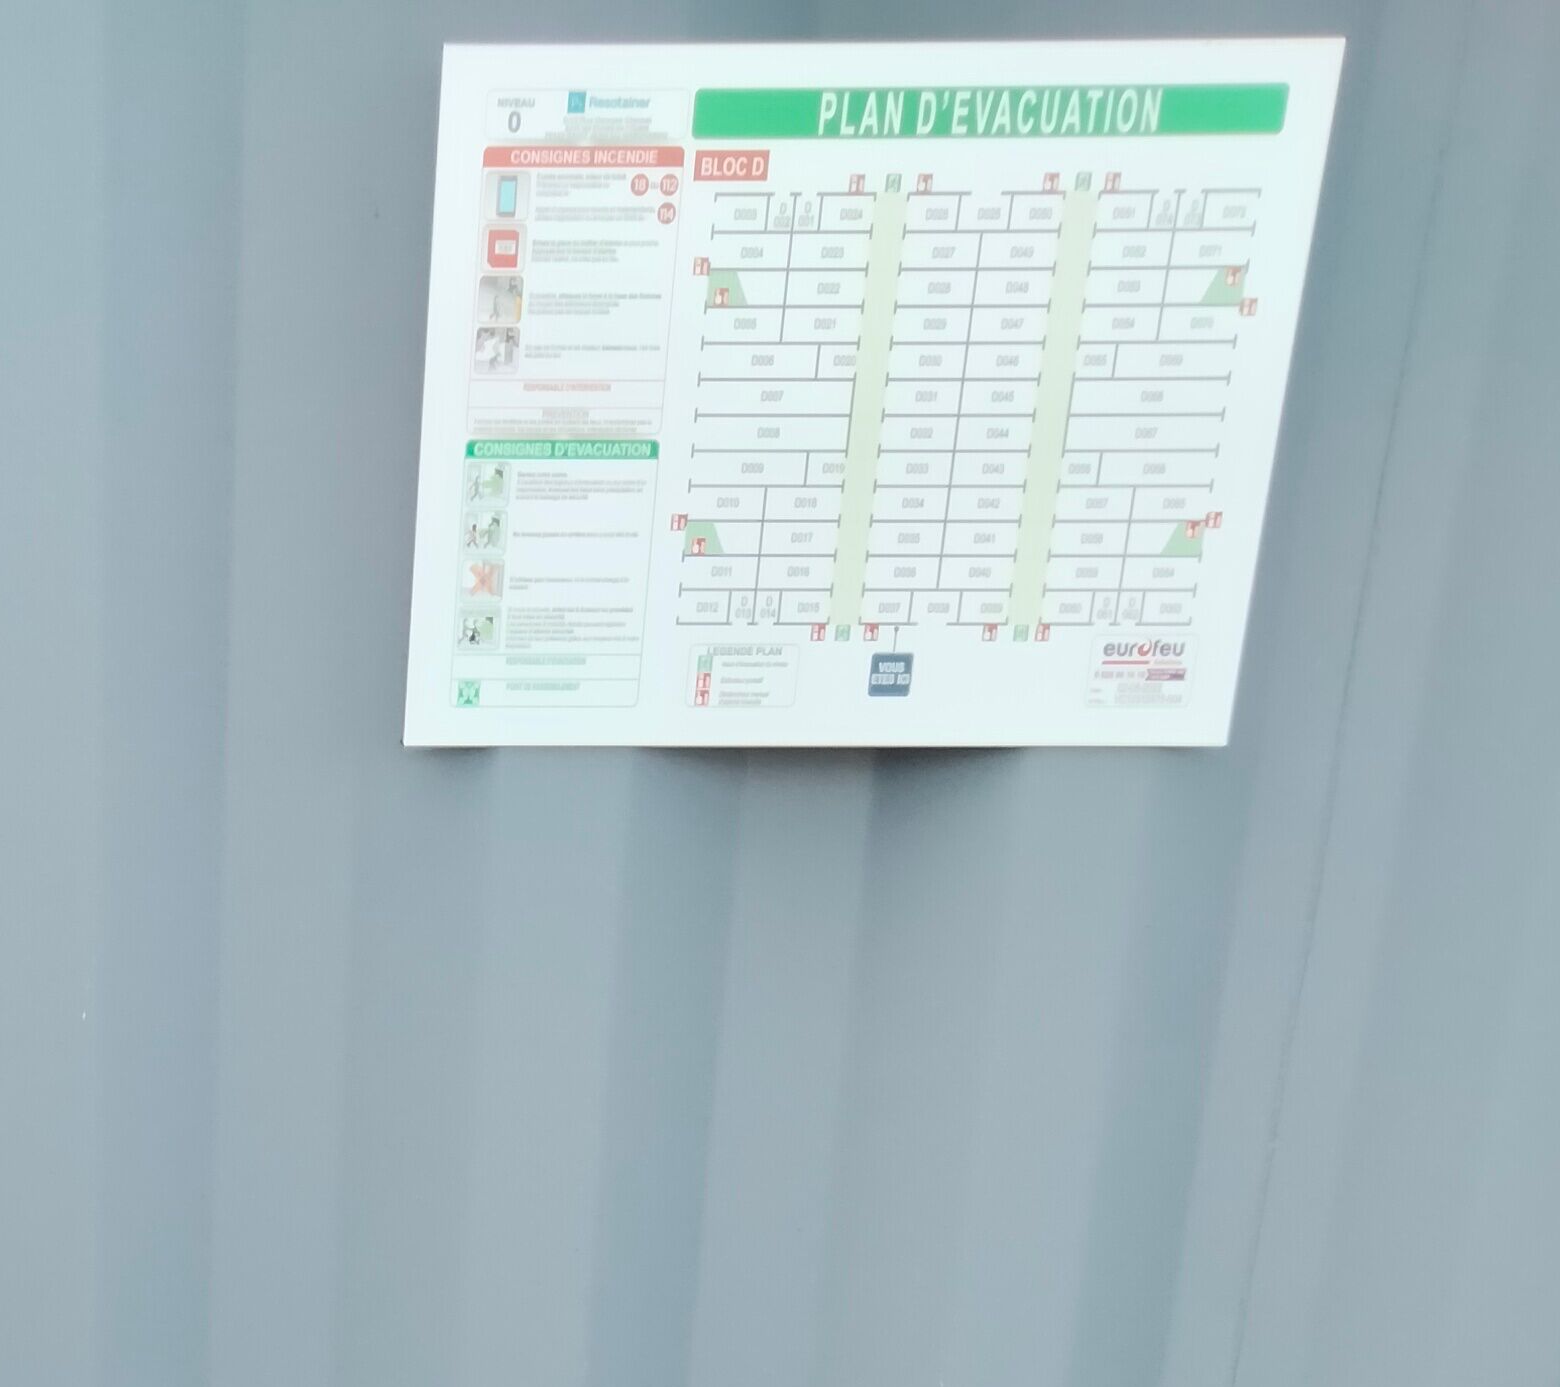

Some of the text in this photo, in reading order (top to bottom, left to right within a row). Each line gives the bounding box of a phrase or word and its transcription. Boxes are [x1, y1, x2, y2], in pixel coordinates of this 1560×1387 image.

[497, 98, 536, 108] NIVEAU
[818, 87, 1163, 136] PLAN D'EVACUATION
[507, 111, 522, 133] 0
[510, 149, 658, 164] CONSIGNES INCENDIE
[701, 156, 765, 176] BLOC D
[474, 441, 651, 457] CONSIGNES D'EVACUATION
[756, 646, 783, 656] PLAN
[1102, 639, 1186, 657] eurofeu
